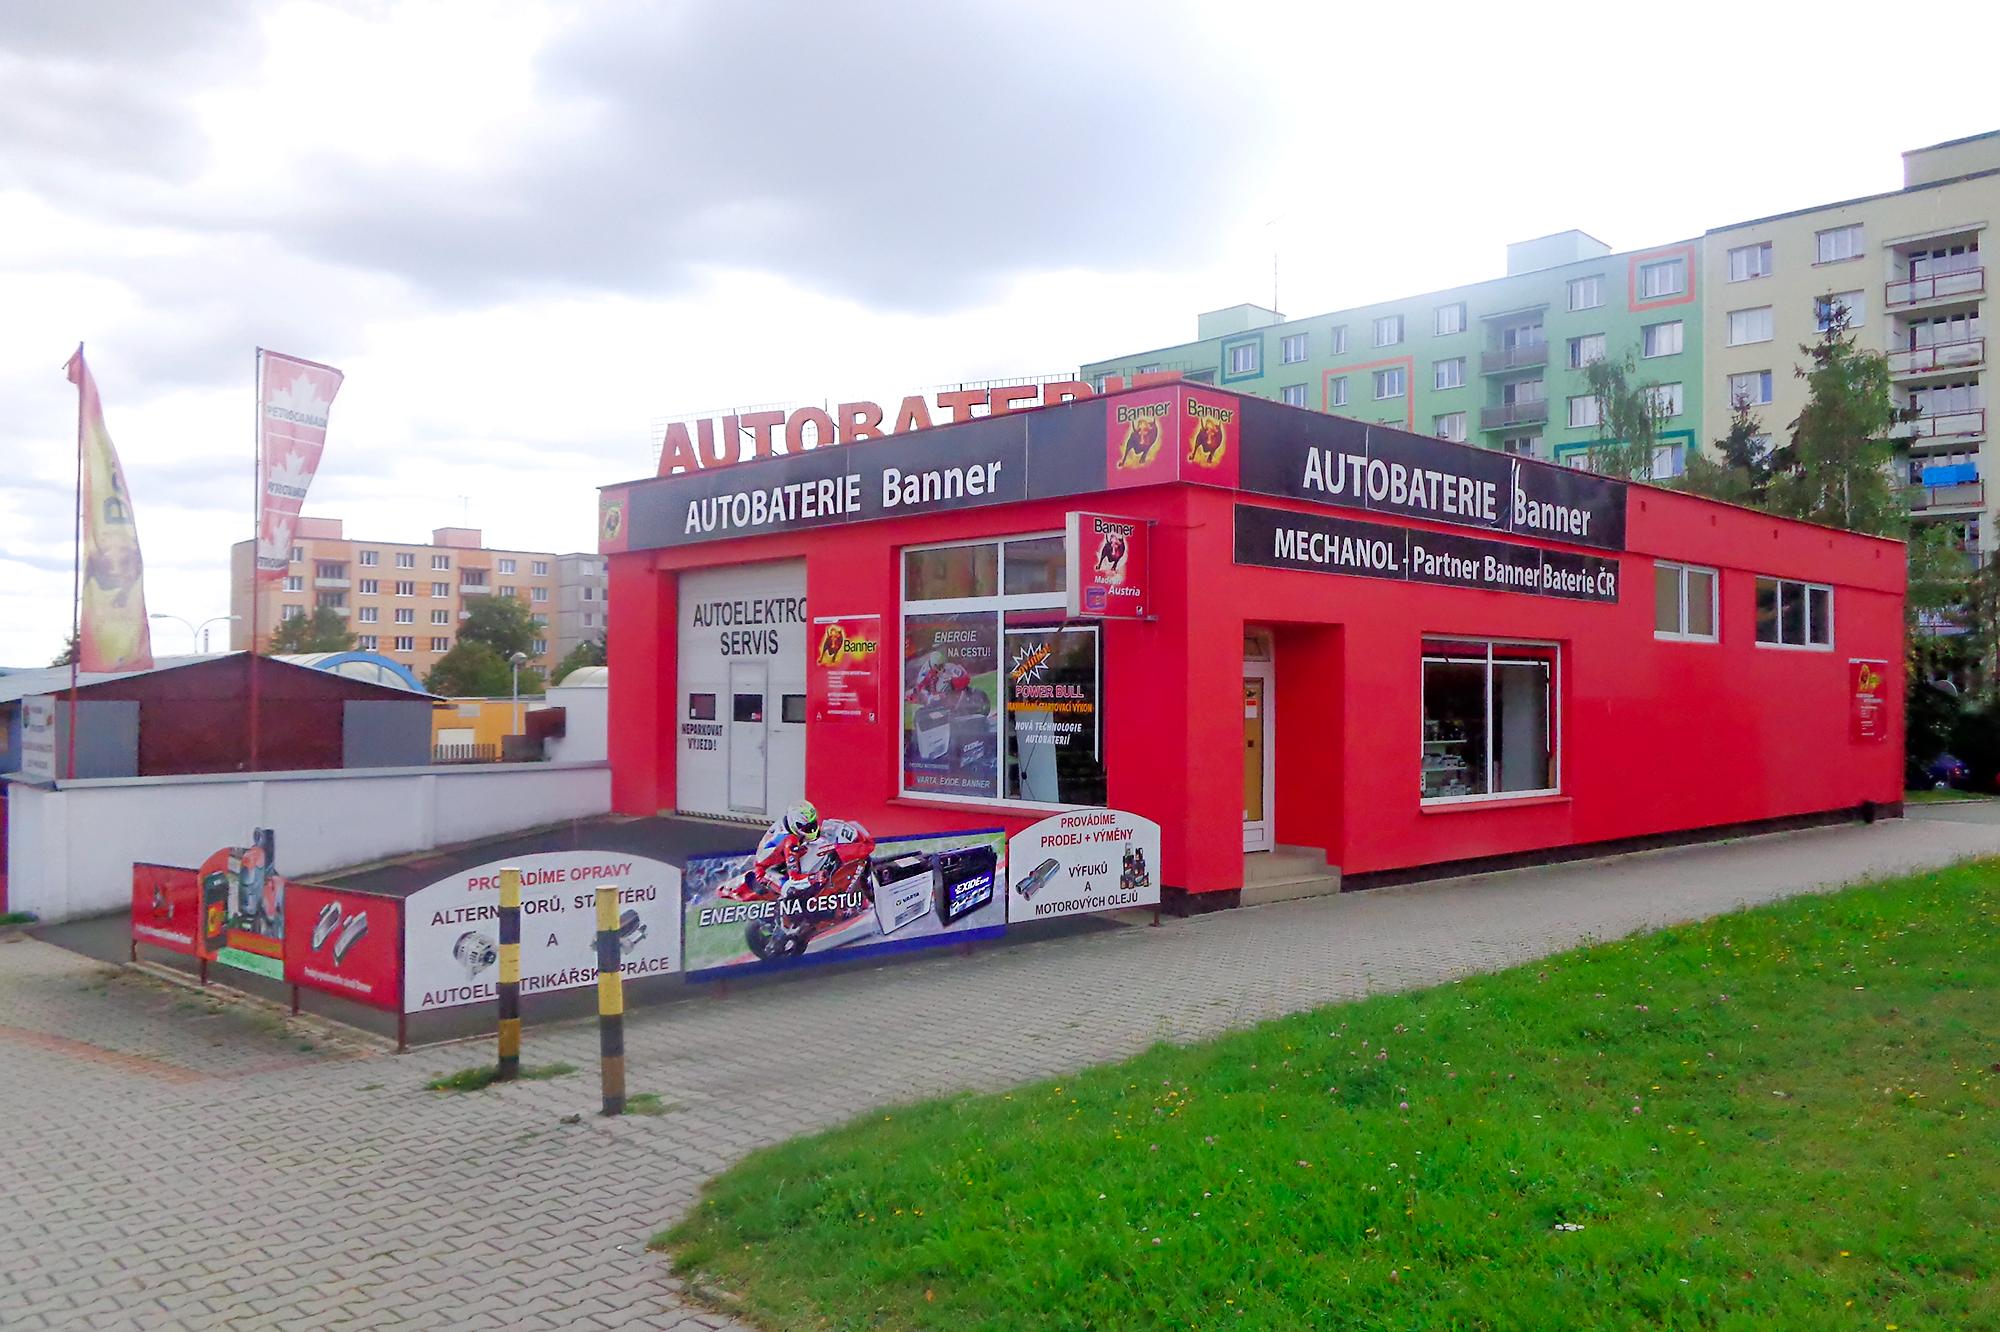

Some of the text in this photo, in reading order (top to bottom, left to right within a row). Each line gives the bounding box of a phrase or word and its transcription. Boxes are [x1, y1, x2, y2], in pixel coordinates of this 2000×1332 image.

[1117, 401, 1170, 423] Banner
[1188, 398, 1233, 422] Banner
[657, 370, 1184, 479] AUTOBATE
[684, 461, 1002, 534] AUTOBATERIE Banner
[1303, 446, 1592, 537] AUTOBATERIE Banner
[1094, 519, 1134, 537] Banner
[1274, 528, 1398, 571] MECHANOL
[1413, 545, 1480, 581] Partner
[1484, 555, 1540, 588] Banner
[1543, 564, 1595, 595] Baterie
[1597, 566, 1616, 597] ČR
[1107, 584, 1141, 597] Austria
[693, 597, 807, 628] AUTOELEKTRO
[720, 630, 779, 656] SERVIS
[844, 640, 877, 652] Banner
[934, 630, 977, 643] ENERGIE
[948, 646, 991, 657] NA CESTU!
[1015, 685, 1085, 699] POWER BULL
[1014, 720, 1083, 733] NOVÁ TECHNOLOGIE
[1061, 814, 1116, 829] PROVÁDÍME
[1041, 834, 1083, 848] PRODEJ
[1093, 828, 1134, 843] VÝMĚNY
[468, 863, 633, 892] PRODÍME OPRAVY
[1069, 861, 1108, 878] VÝFUKŮ
[1084, 881, 1092, 892] A
[431, 885, 657, 927] ALTERNORŮ, STTÉRŮ
[699, 892, 862, 926] ENERGIE NA CESTU!
[1035, 890, 1139, 916] MOTOROVÝCH OLEJŮ
[547, 933, 558, 948] A
[421, 967, 599, 1007] AUTOELTRIKÁŘSK
